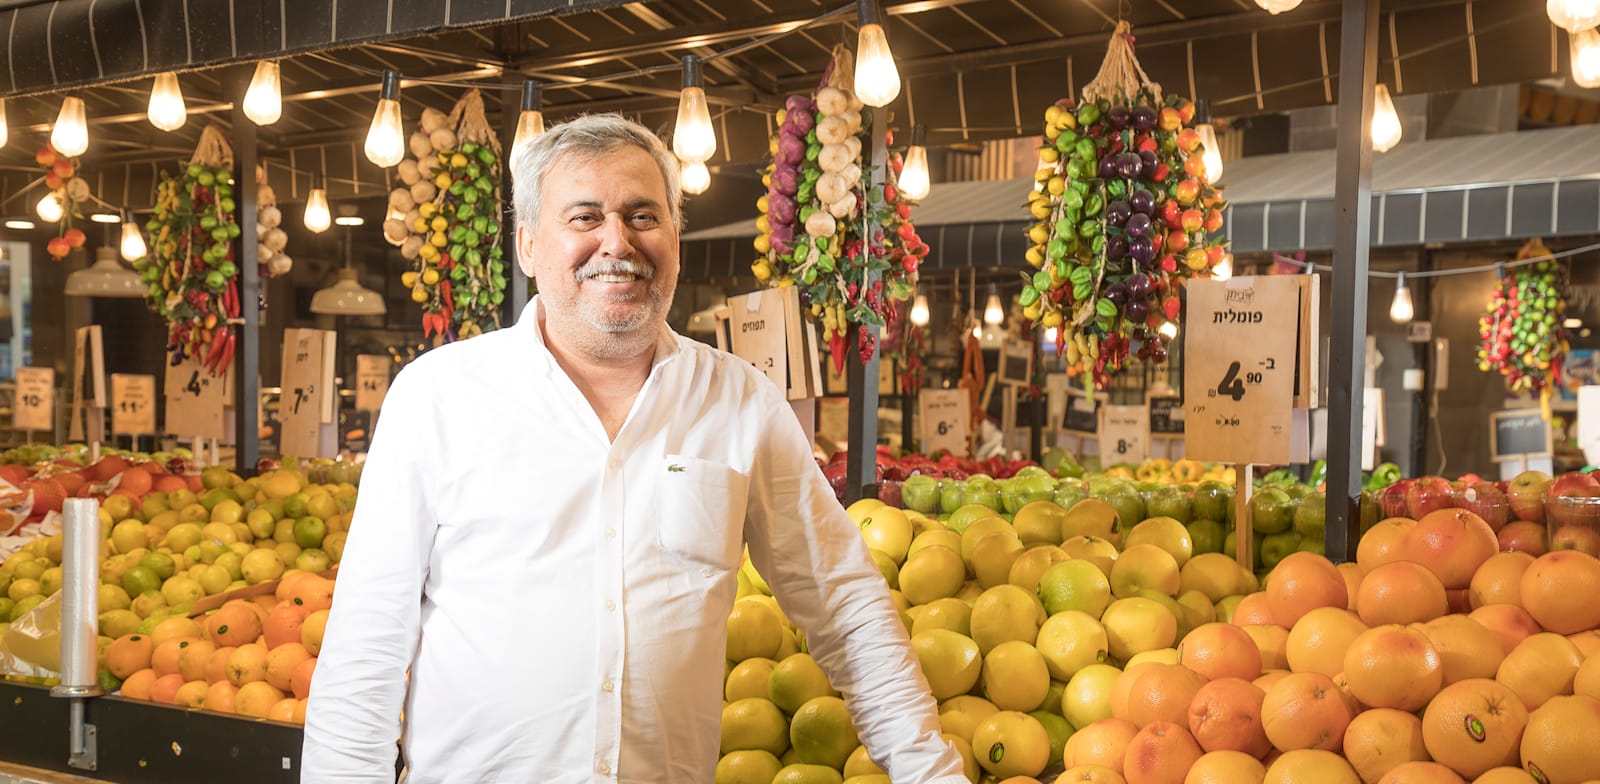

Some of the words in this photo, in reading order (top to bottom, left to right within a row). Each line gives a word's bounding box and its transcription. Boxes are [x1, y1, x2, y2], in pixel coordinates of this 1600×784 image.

[1213, 309, 1263, 324] פומלית
[742, 320, 765, 332] תפוזים
[1259, 358, 1275, 370] ב-
[187, 370, 201, 396] 4
[1218, 361, 1246, 401] 4
[1246, 372, 1263, 384] 90
[294, 388, 304, 415] 7
[938, 421, 948, 436] 6
[1117, 439, 1127, 454] 8
